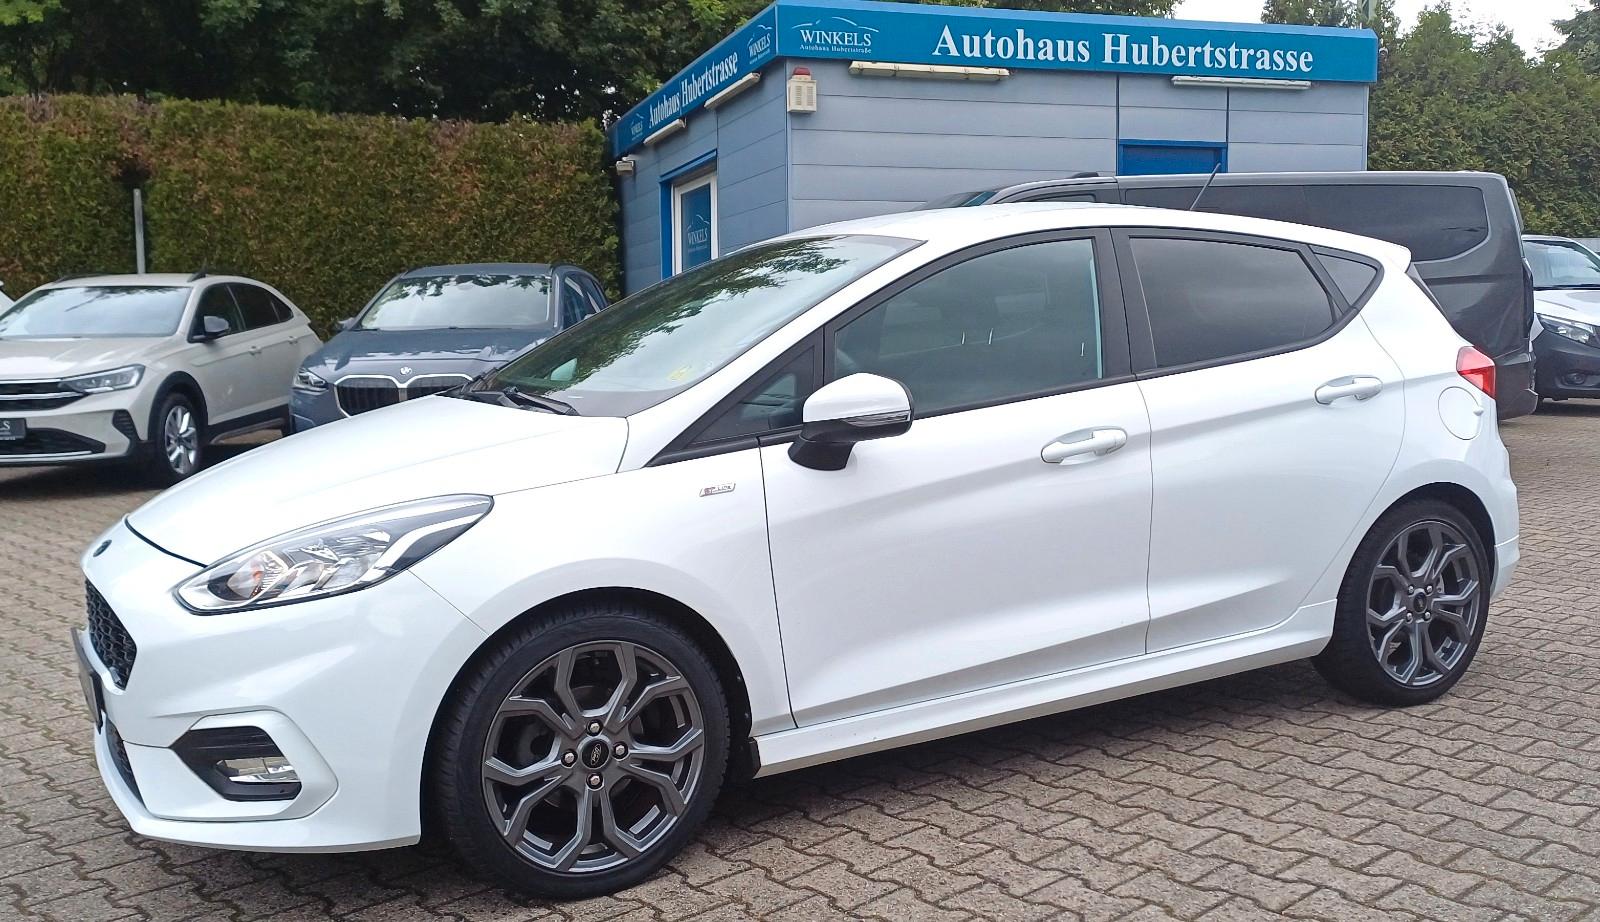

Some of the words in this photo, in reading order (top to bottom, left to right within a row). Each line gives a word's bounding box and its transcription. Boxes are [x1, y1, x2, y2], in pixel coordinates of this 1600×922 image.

[749, 33, 770, 57] WINKELS
[800, 29, 871, 46] WINKELS
[800, 44, 829, 52] Autohaus
[932, 24, 1089, 63] Autohaus
[1101, 33, 1313, 73] Hubertstrasse
[649, 94, 680, 129] Autohaus
[681, 52, 738, 107] Hubertstrasse
